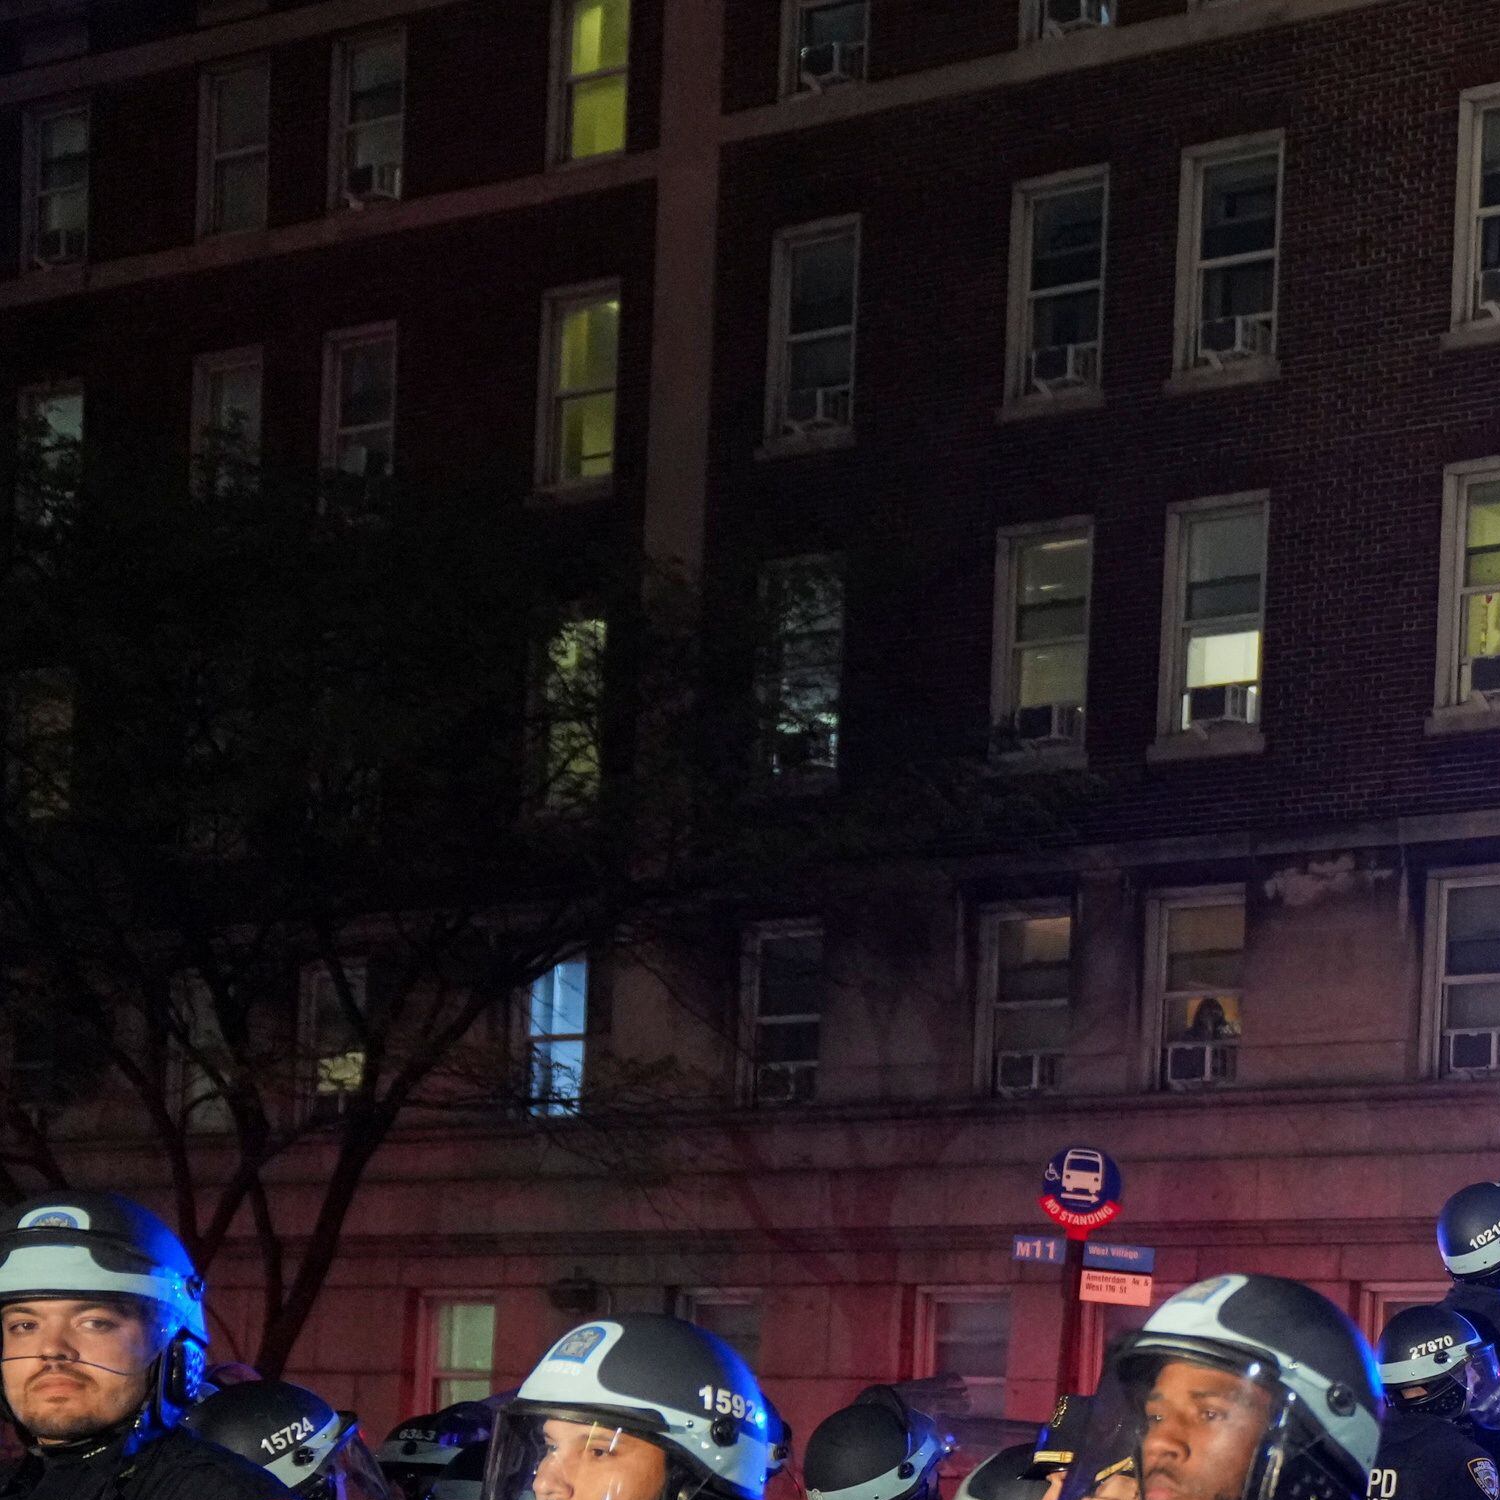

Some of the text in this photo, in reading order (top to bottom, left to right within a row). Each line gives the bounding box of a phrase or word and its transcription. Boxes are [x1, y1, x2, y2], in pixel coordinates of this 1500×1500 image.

[1044, 1197, 1114, 1226] NO STANDING
[1016, 1239, 1056, 1260] M11
[1088, 1245, 1139, 1260] West Village
[1085, 1283, 1103, 1292] West
[1086, 1273, 1126, 1284] Amsterdam
[1409, 1334, 1453, 1360] 27870
[699, 1384, 764, 1425] 1592
[260, 1416, 315, 1455] 15724
[1366, 1468, 1398, 1499] PD
